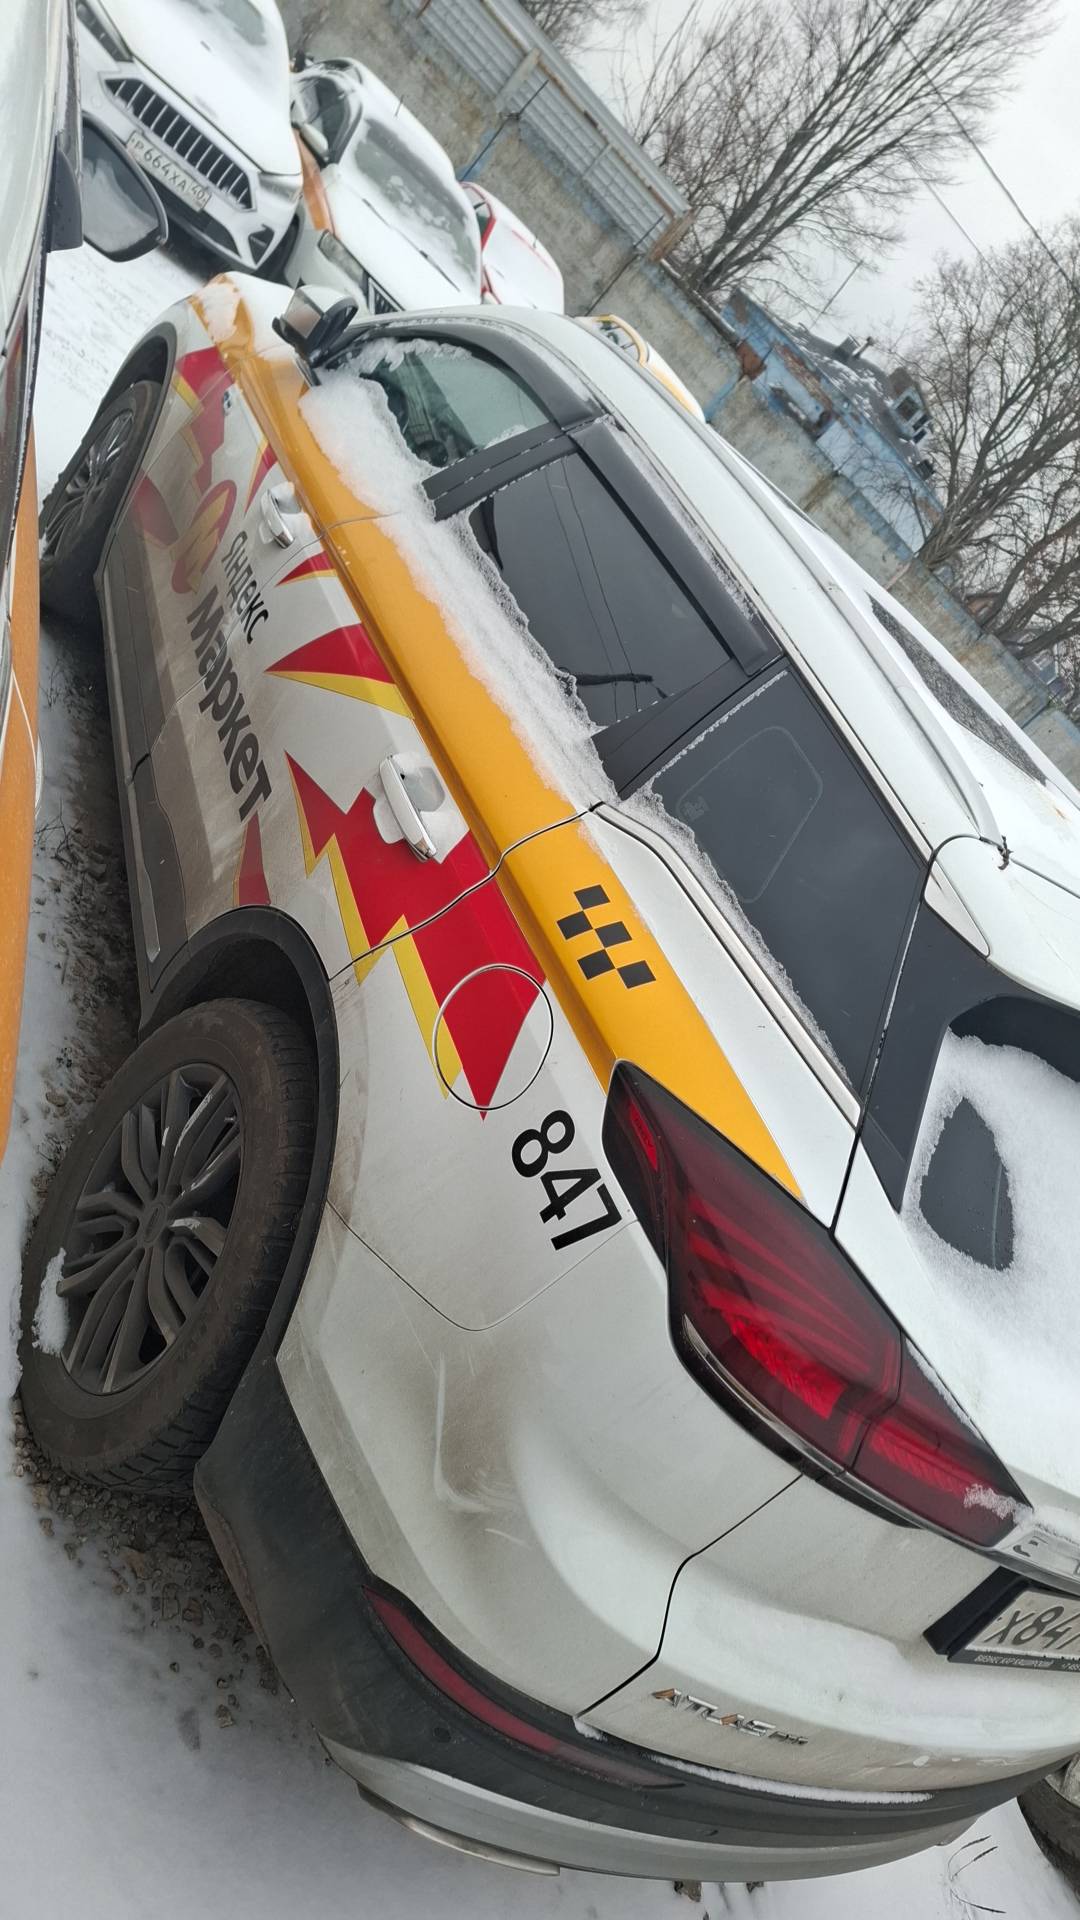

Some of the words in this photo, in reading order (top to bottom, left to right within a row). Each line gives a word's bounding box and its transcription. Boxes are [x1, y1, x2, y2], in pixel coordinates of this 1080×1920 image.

[220, 530, 269, 645] Яндекс
[186, 585, 273, 823] Маркет
[511, 1109, 623, 1251] 847
[652, 1687, 777, 1737] ATLAS
